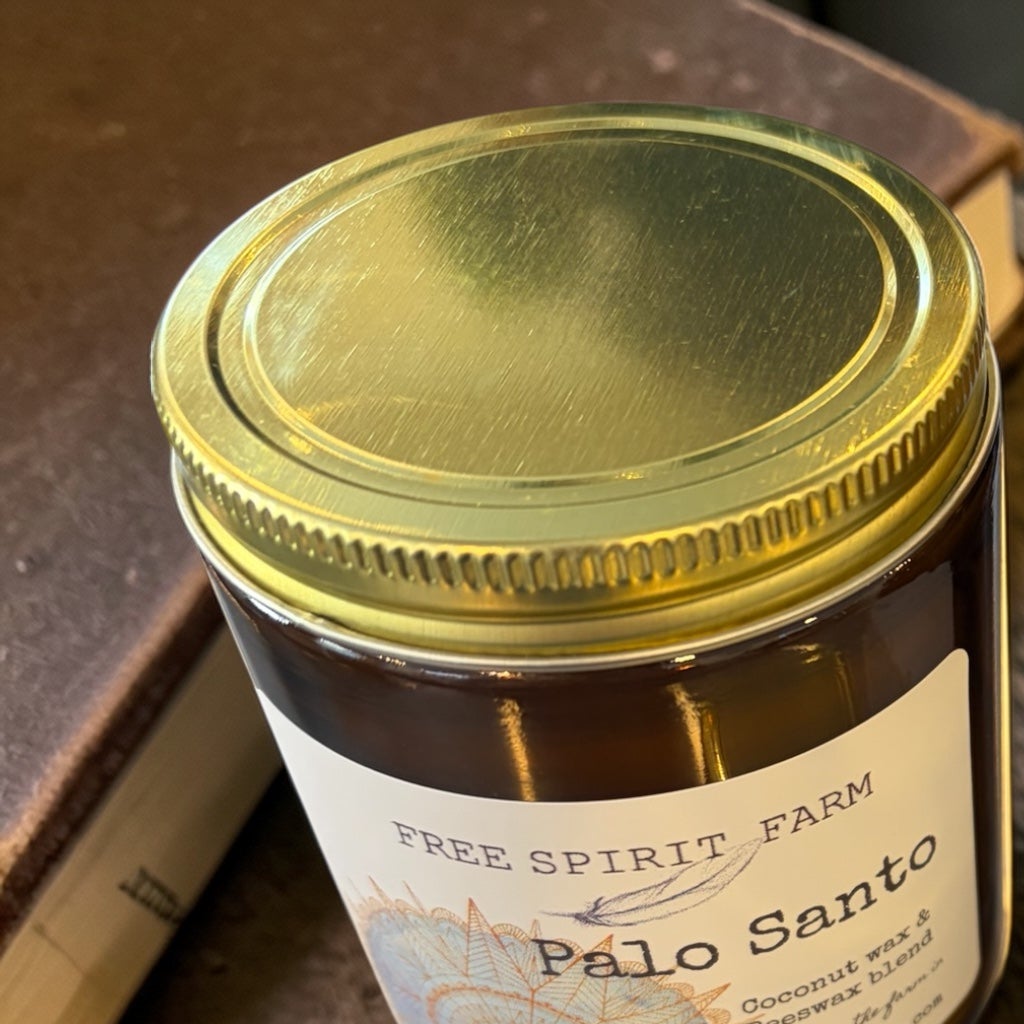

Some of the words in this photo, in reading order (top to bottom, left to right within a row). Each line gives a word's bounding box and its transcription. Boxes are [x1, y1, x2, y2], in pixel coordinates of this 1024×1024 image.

[392, 821, 512, 871] FREE
[530, 833, 727, 876] SPIRIT
[759, 771, 875, 843] FARM
[532, 938, 720, 979] Palo
[748, 834, 938, 957] Santo
[869, 929, 935, 986] blend
[741, 957, 860, 1015] Coconut
[865, 928, 911, 963] wax
[915, 908, 932, 929] &
